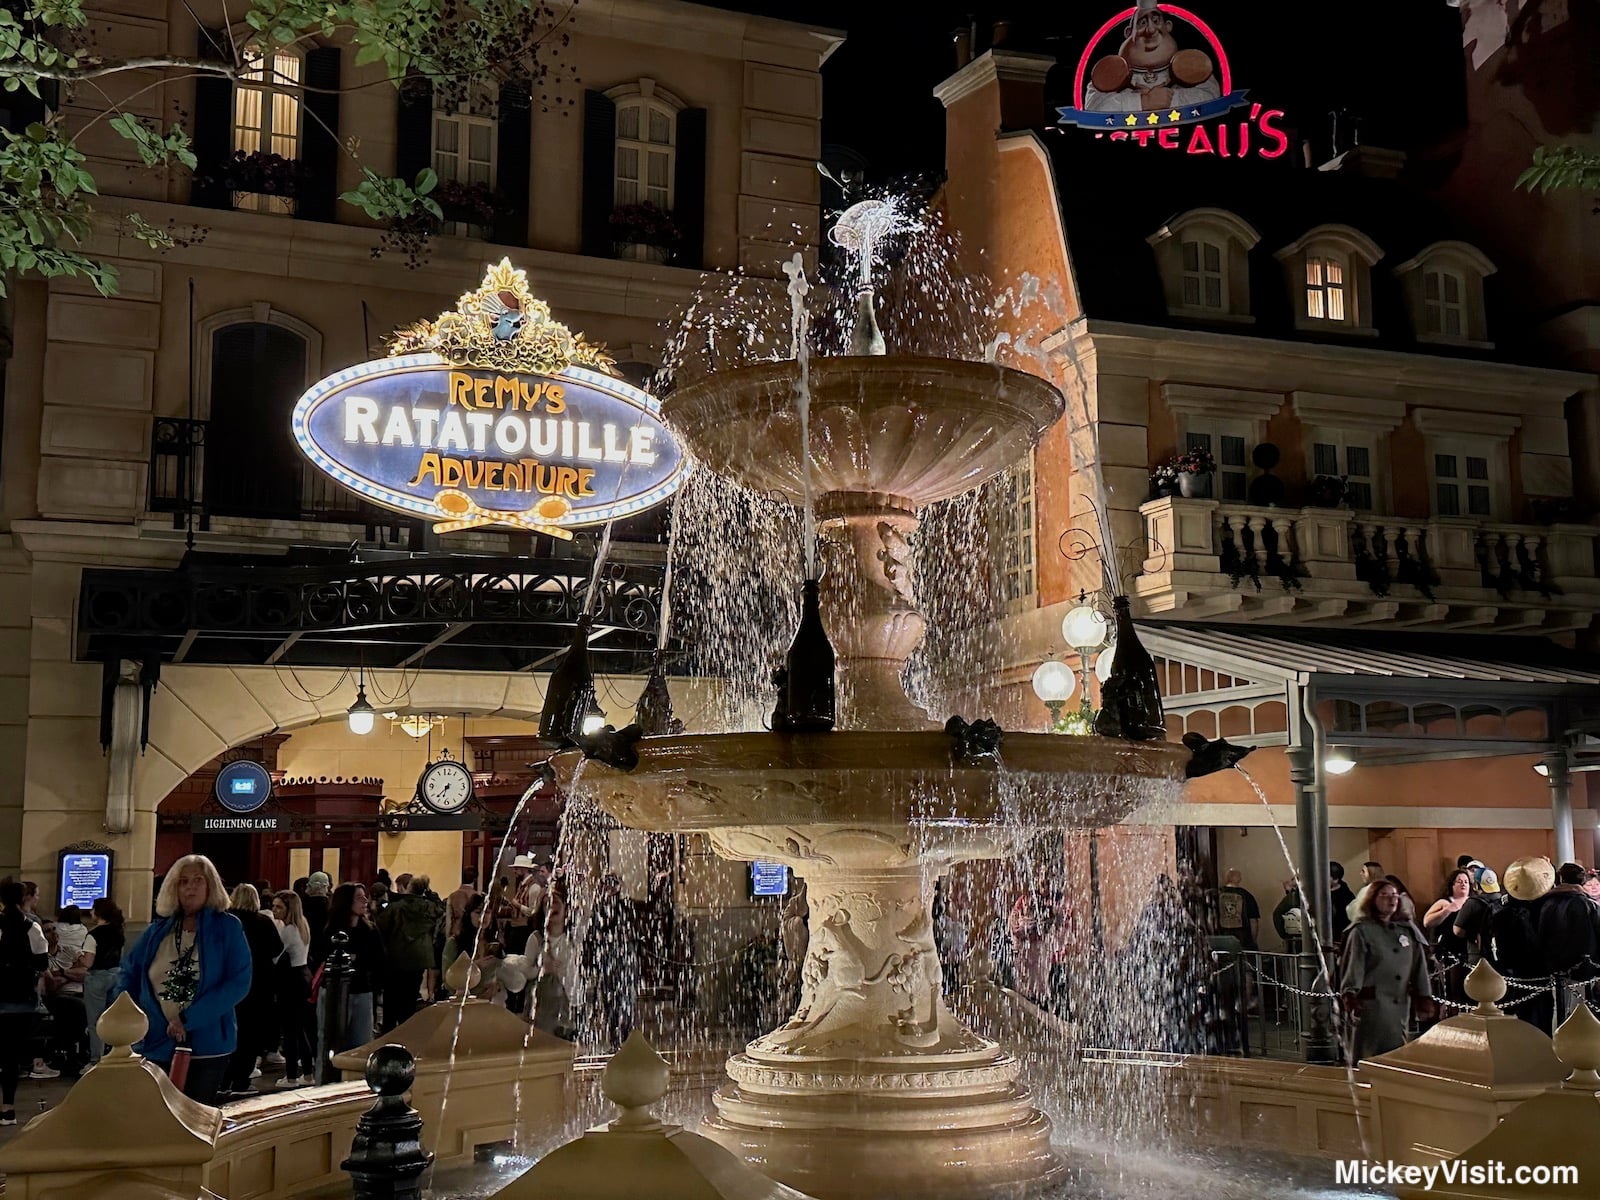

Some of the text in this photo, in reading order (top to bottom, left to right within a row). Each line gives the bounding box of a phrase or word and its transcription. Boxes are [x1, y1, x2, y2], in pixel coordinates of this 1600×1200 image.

[448, 371, 567, 415] REMY'S
[343, 396, 656, 466] RATATOUILLE
[407, 453, 597, 498] ADVENTURE
[443, 768, 452, 776] 12
[459, 782, 466, 791] 3
[204, 818, 278, 829] LIGHTNING LANE
